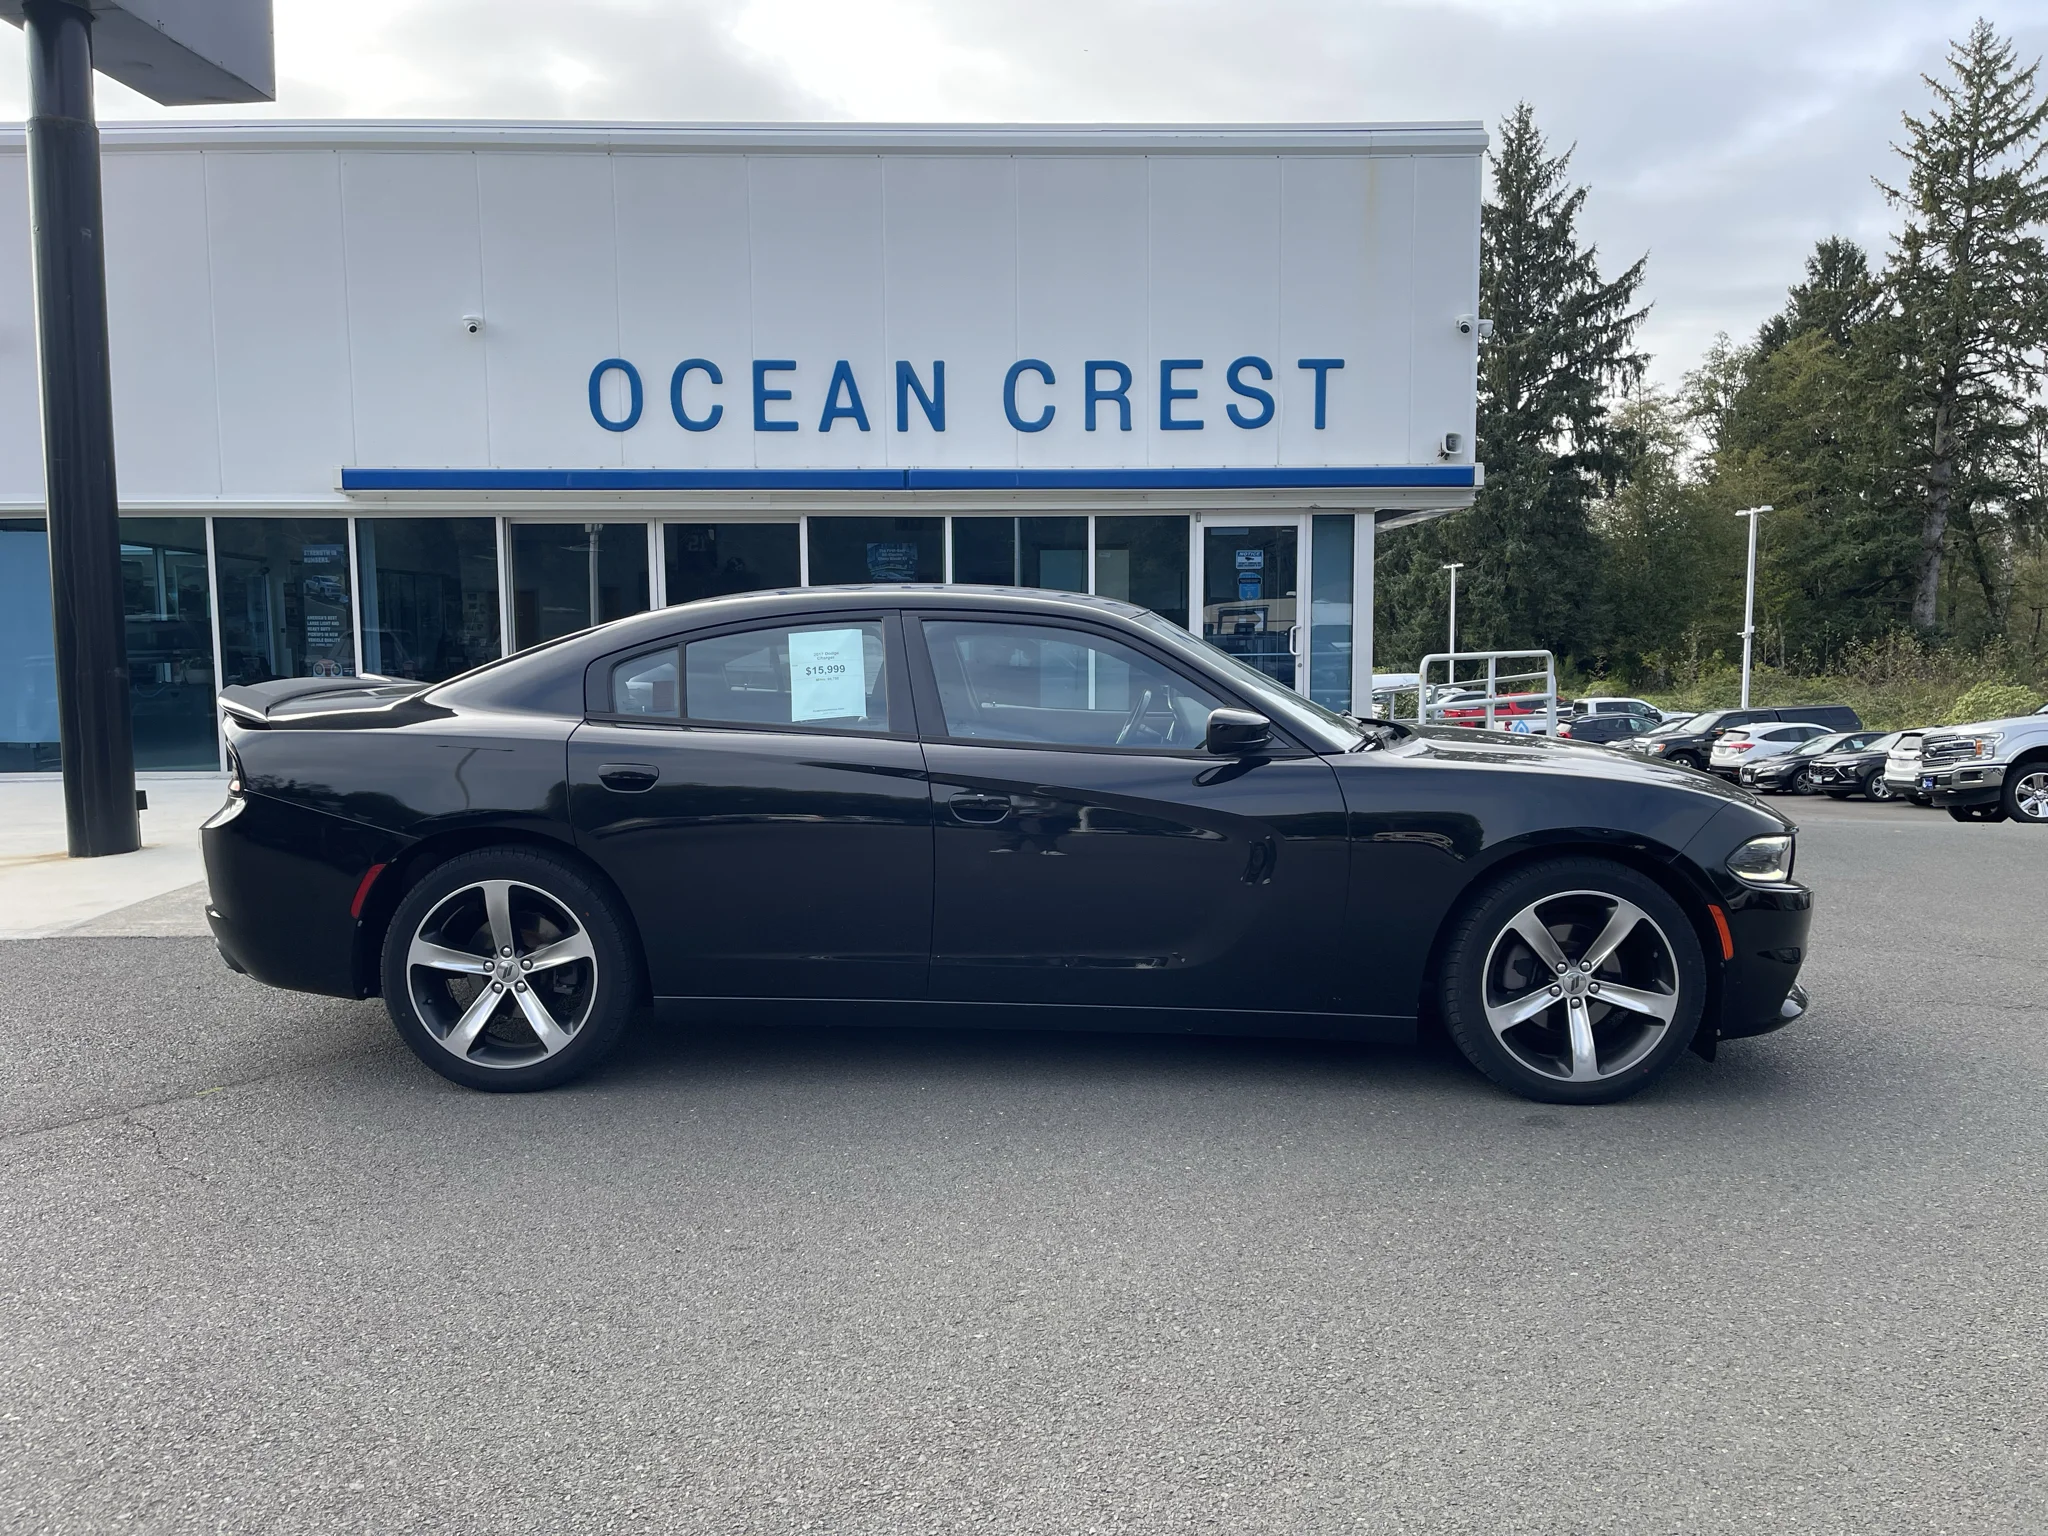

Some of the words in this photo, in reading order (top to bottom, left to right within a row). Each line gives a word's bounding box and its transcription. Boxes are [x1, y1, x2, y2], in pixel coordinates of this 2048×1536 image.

[588, 358, 946, 433] OCEAN
[1002, 355, 1346, 433] CREST
[805, 664, 846, 677] $15,999
